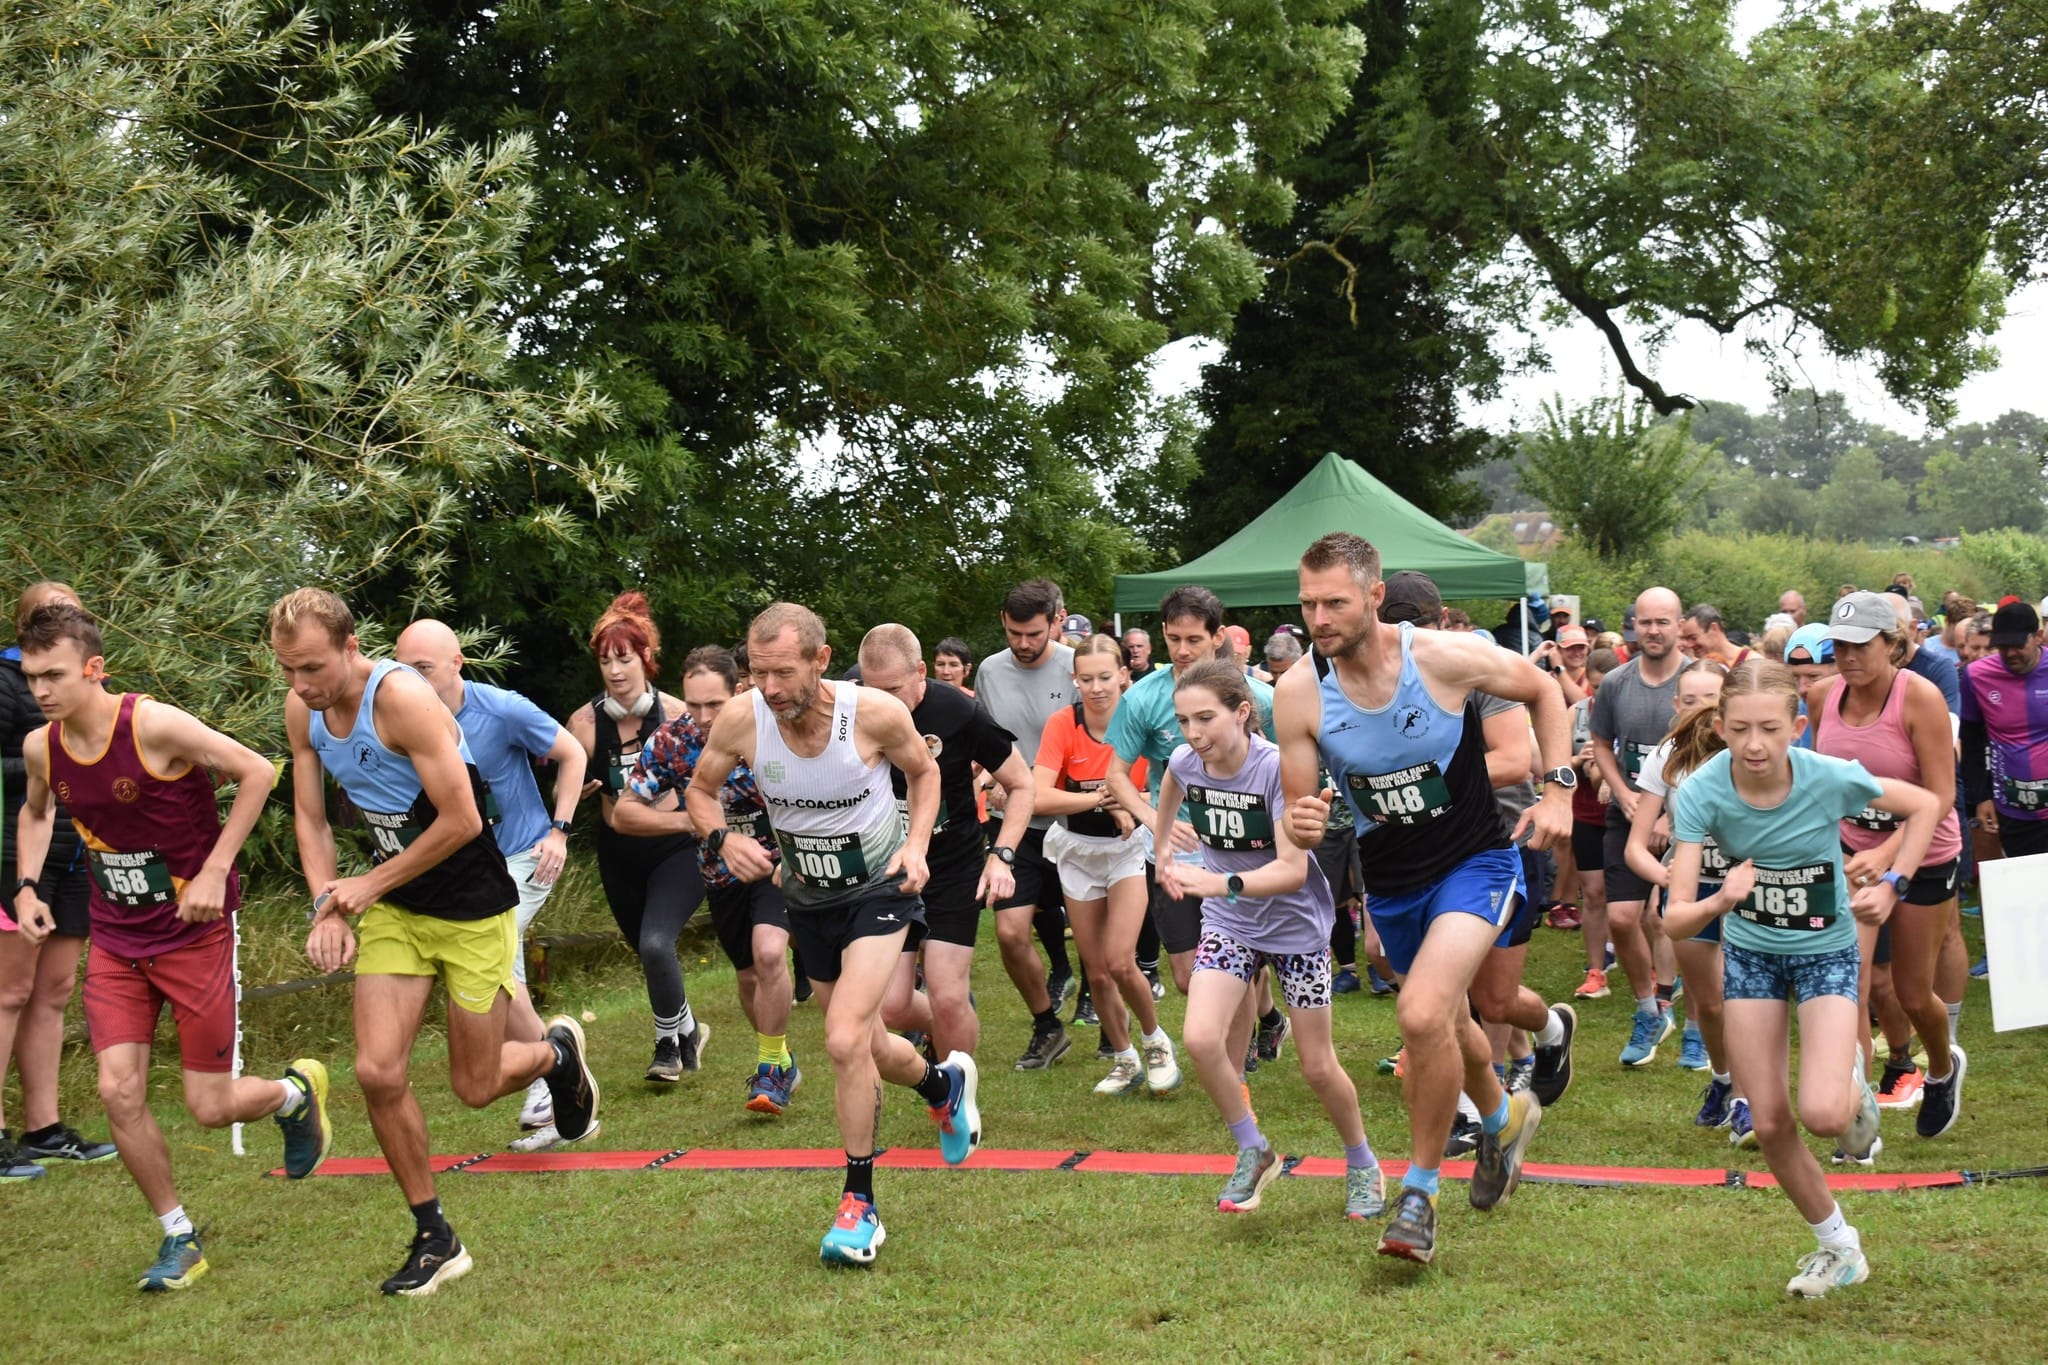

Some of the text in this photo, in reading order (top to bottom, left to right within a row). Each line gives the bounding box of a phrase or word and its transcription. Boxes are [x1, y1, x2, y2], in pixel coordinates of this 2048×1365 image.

[1367, 764, 1431, 783] WINWICK HALL
[1370, 774, 1422, 790] TRAIL RACES
[1205, 789, 1257, 804] WINWICK HALL
[1371, 785, 1425, 815] 148
[2018, 790, 2039, 804] 48
[1225, 800, 1249, 810] RACES
[1204, 808, 1245, 839] 179
[1400, 815, 1414, 825] 2K
[1430, 806, 1444, 817] 5K
[374, 826, 405, 853] 84
[831, 836, 851, 845] HALL
[1223, 839, 1235, 848] 2K
[795, 851, 842, 879] 100
[1802, 866, 1825, 876] HALL
[103, 868, 149, 895] 158
[818, 876, 858, 888] 2K 5K
[1782, 875, 1815, 885] RACES
[126, 896, 139, 905] 2K
[153, 892, 168, 902] 5K
[1752, 885, 1808, 916] 183
[1740, 908, 1825, 929] 10K 2K 5K
